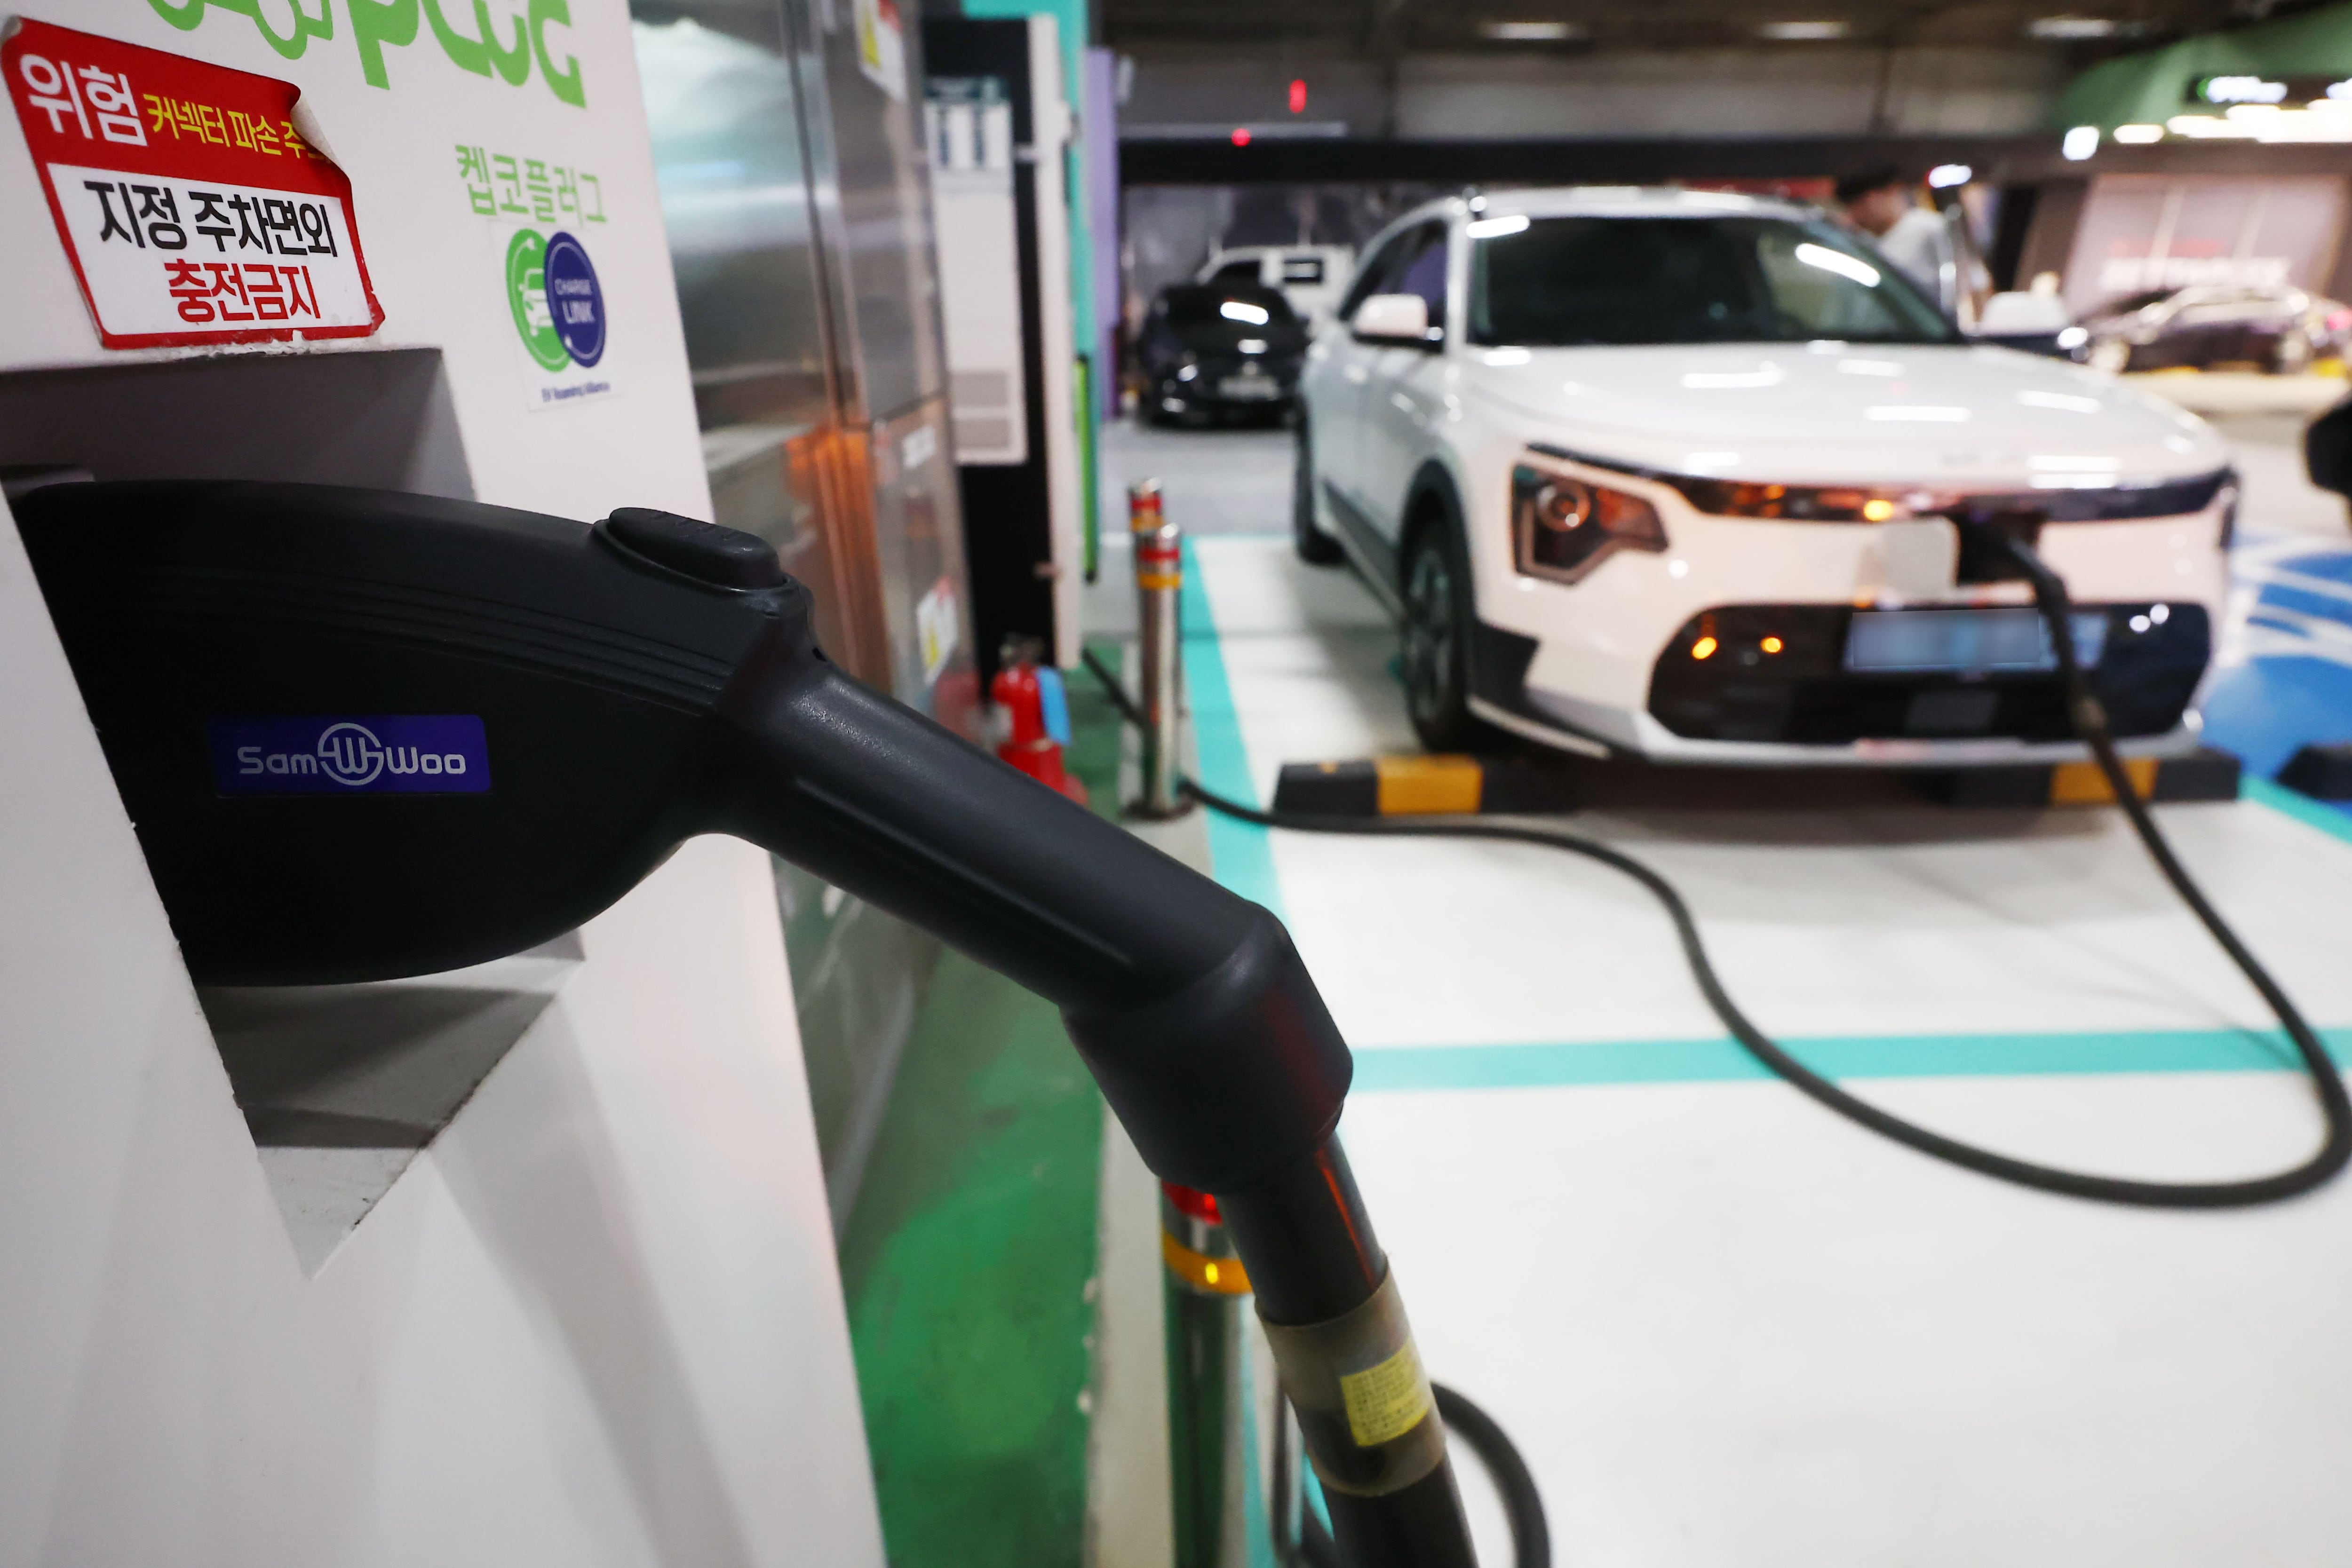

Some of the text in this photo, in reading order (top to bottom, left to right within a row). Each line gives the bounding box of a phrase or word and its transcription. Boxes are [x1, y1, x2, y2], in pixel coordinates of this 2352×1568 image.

[19, 54, 330, 165] 위험 커넥터 파손 주
[83, 181, 338, 257] 지정 주차면외
[455, 144, 607, 226] 켑코플러그
[164, 258, 321, 323] 충전금지
[237, 746, 318, 774] Sam
[386, 746, 466, 774] Woo
